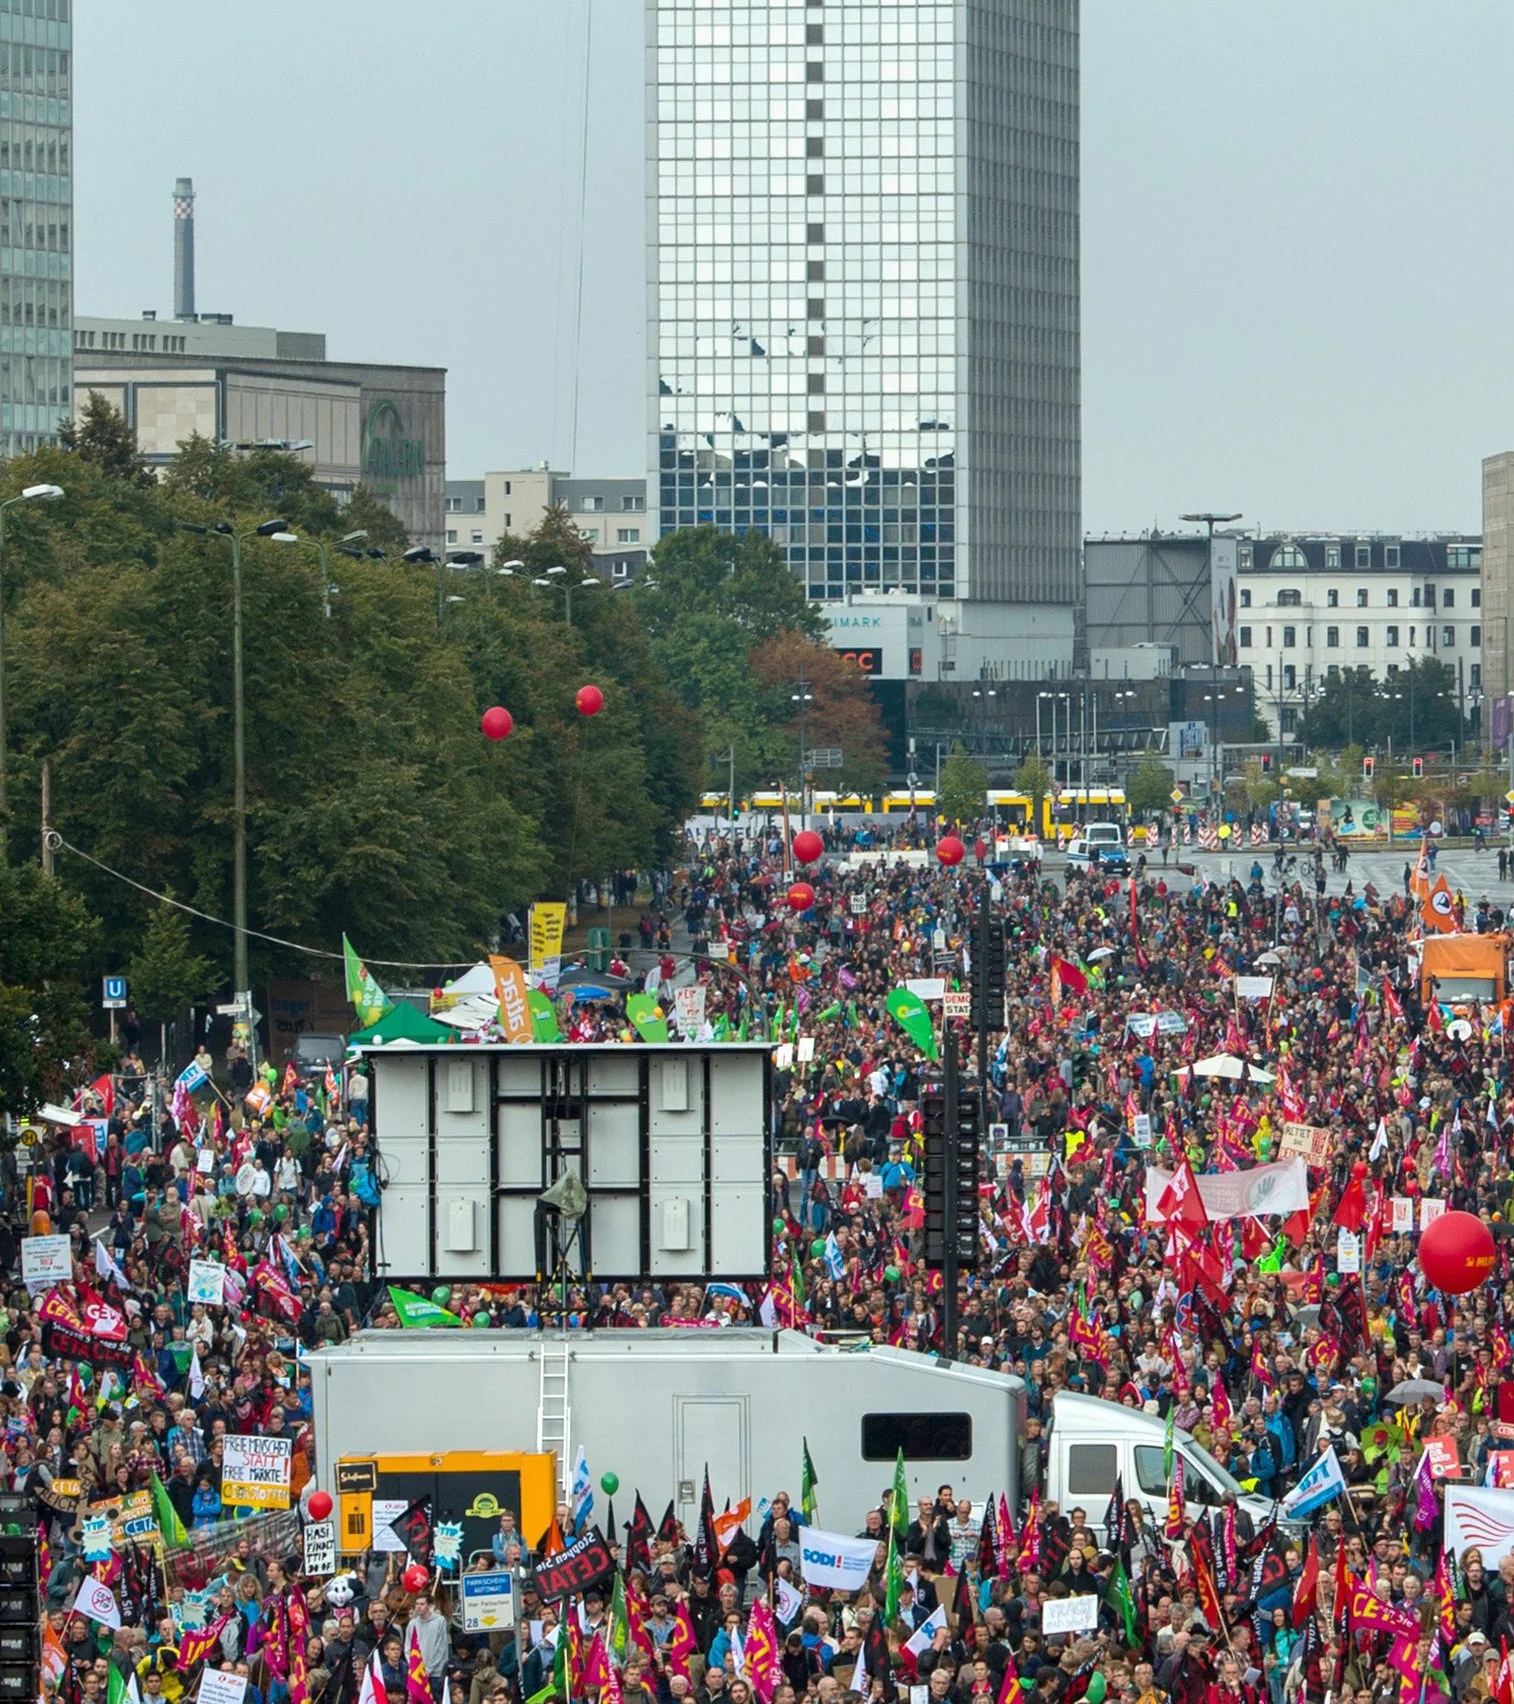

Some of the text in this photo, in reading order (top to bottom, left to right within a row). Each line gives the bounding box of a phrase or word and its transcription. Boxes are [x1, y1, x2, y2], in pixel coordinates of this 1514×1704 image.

[831, 616, 881, 628] IMARK
[853, 895, 865, 903] NO
[109, 981, 121, 997] U
[119, 1342, 133, 1354] Sie
[242, 1452, 279, 1467] STATT
[51, 1482, 80, 1494] CETA
[86, 1520, 106, 1531] TTIP
[124, 1516, 158, 1535] CETA
[441, 1527, 458, 1537] TTIP
[803, 1548, 842, 1569] SODI!
[466, 1577, 508, 1587] PARKSCHEIN-
[474, 1585, 502, 1594] AUTOMAT
[467, 1618, 479, 1628] 28
